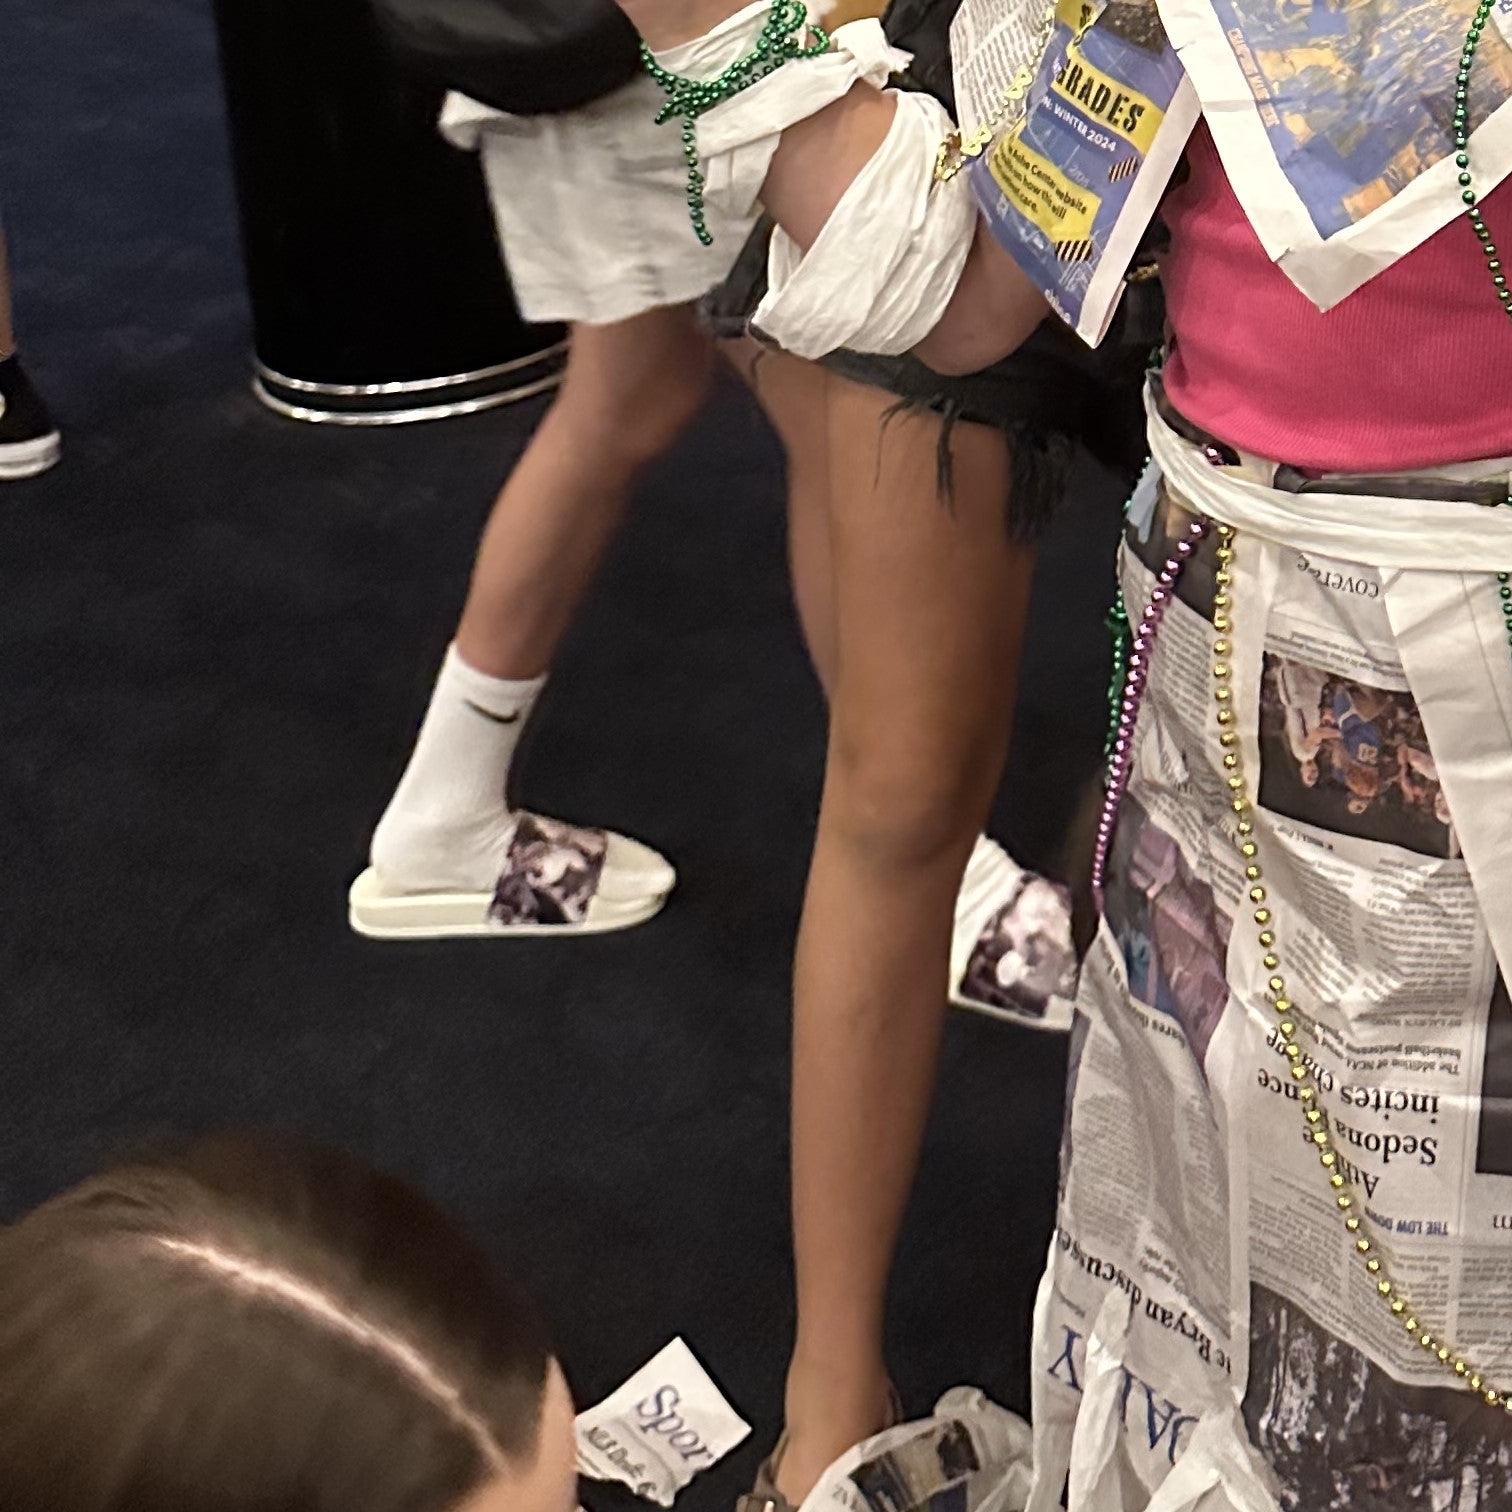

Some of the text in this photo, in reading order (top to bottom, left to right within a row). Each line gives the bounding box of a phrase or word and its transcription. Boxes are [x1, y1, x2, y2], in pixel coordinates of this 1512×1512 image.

[1050, 102, 1091, 136] WINTER
[1086, 126, 1118, 155] 2024
[1052, 185, 1089, 215] website
[1266, 1026, 1334, 1094] chage
[1340, 1085, 1441, 1125] incites
[1396, 1219, 1423, 1235] LOW
[1427, 1220, 1449, 1236] THE
[1145, 1299, 1211, 1364] Bryan
[635, 1384, 714, 1462] Spor
